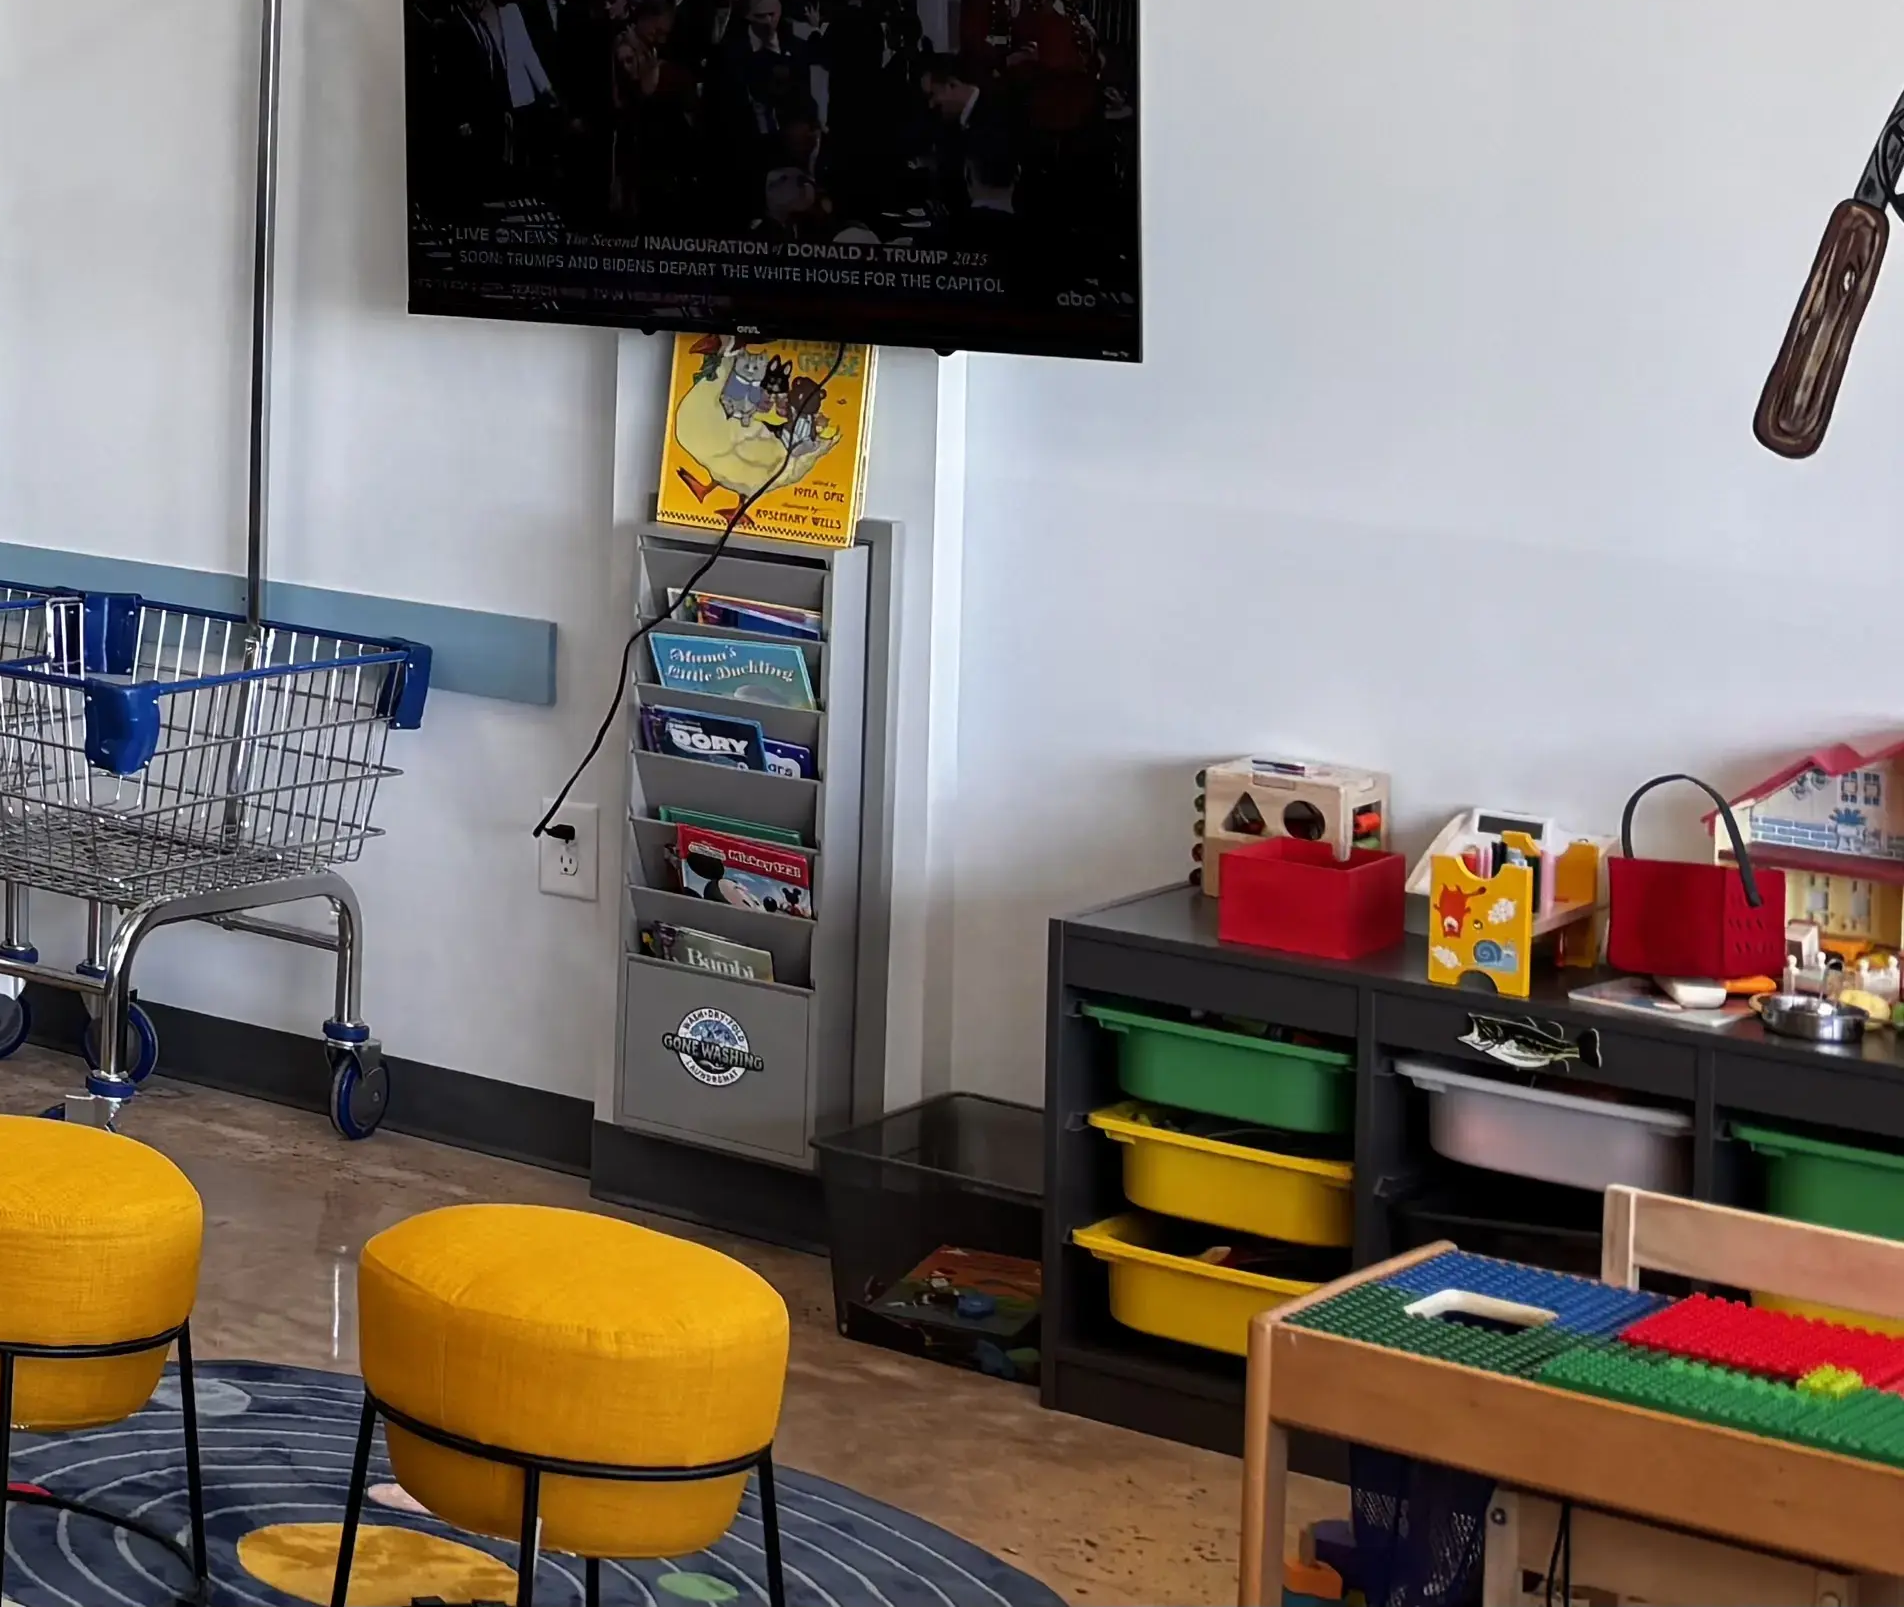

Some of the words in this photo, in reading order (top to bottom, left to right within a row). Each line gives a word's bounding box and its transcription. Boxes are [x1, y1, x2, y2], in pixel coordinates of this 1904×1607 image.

[455, 227, 490, 241] LIVE
[510, 229, 560, 245] NEWS
[591, 232, 640, 249] Second
[644, 235, 769, 256] INAUGURATION
[787, 243, 862, 261] DONALD
[866, 246, 879, 262] J.
[886, 247, 949, 265] TRUMP
[952, 251, 989, 267] 2025
[459, 250, 503, 264] SOON:
[507, 252, 564, 268] TRUMPS
[567, 255, 598, 271] AND
[603, 257, 655, 274] BIDENS
[659, 260, 716, 277] DEPART
[721, 263, 749, 279] THE
[753, 265, 801, 282] WHITE
[805, 268, 860, 285] HOUSE
[864, 271, 896, 287] FOR
[900, 273, 931, 289] THE
[935, 275, 1005, 293] CAPITOL
[1056, 289, 1097, 307] abc
[755, 508, 808, 525] ROSEMARY
[812, 516, 842, 530] WELLS
[669, 644, 737, 663] Mama's
[665, 664, 712, 682] Little
[715, 659, 795, 682] Duckling
[670, 729, 748, 755] DORY
[768, 762, 793, 777] ars
[686, 947, 755, 979] Bambi
[663, 1034, 700, 1057] GONE
[701, 1041, 763, 1070] WASHING
